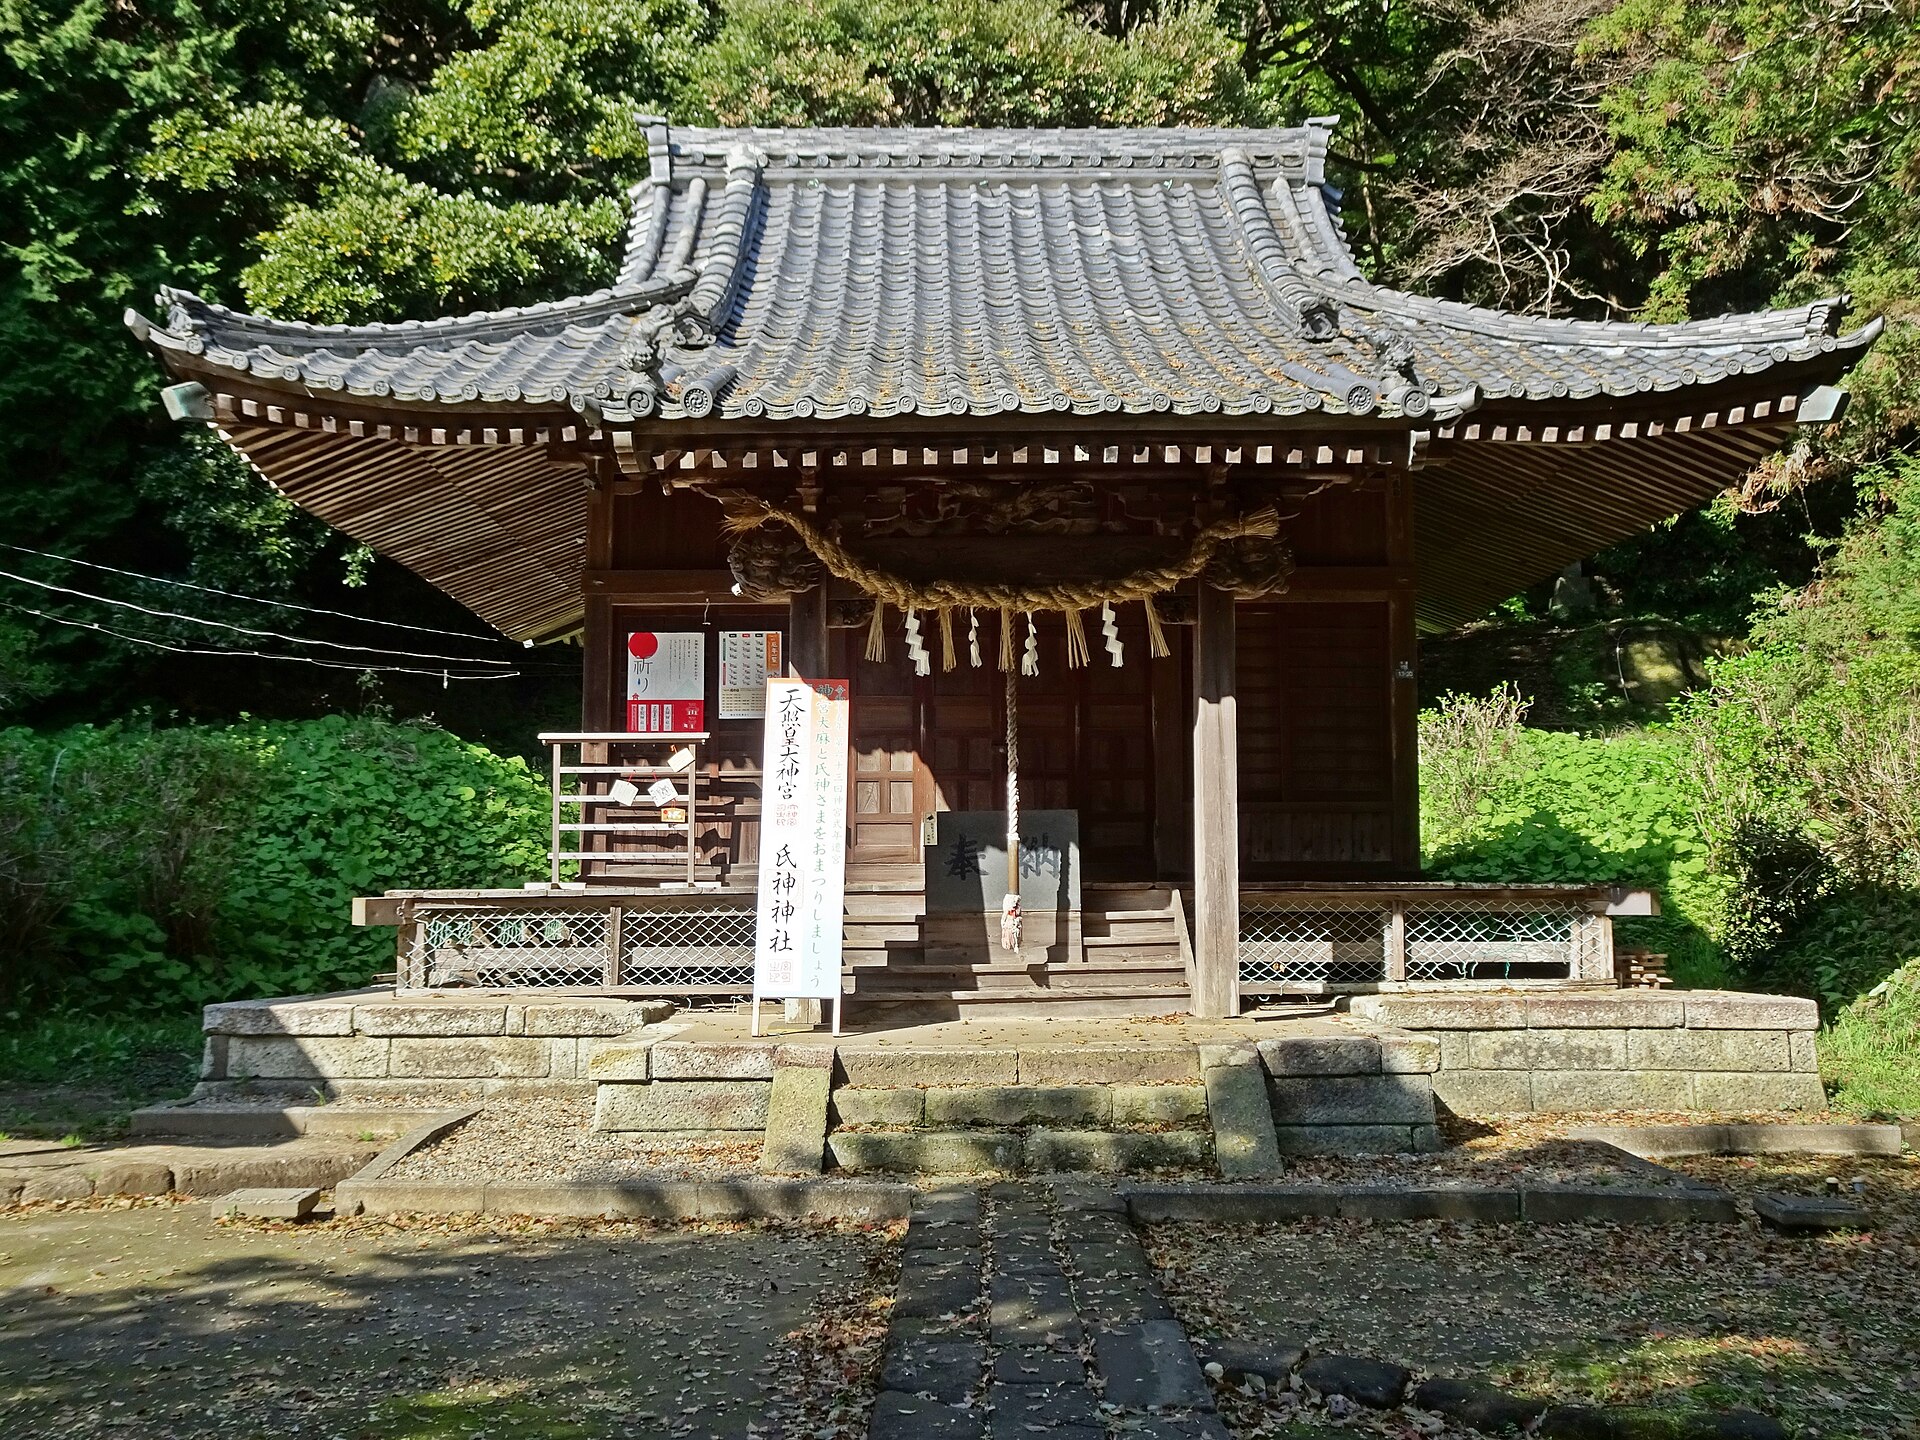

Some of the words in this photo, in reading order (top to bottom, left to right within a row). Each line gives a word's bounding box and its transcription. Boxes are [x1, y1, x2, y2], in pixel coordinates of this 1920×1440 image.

[633, 658, 653, 693] 祈り
[776, 688, 806, 800] 天照皇大神宮
[769, 843, 797, 953] 氏神神社
